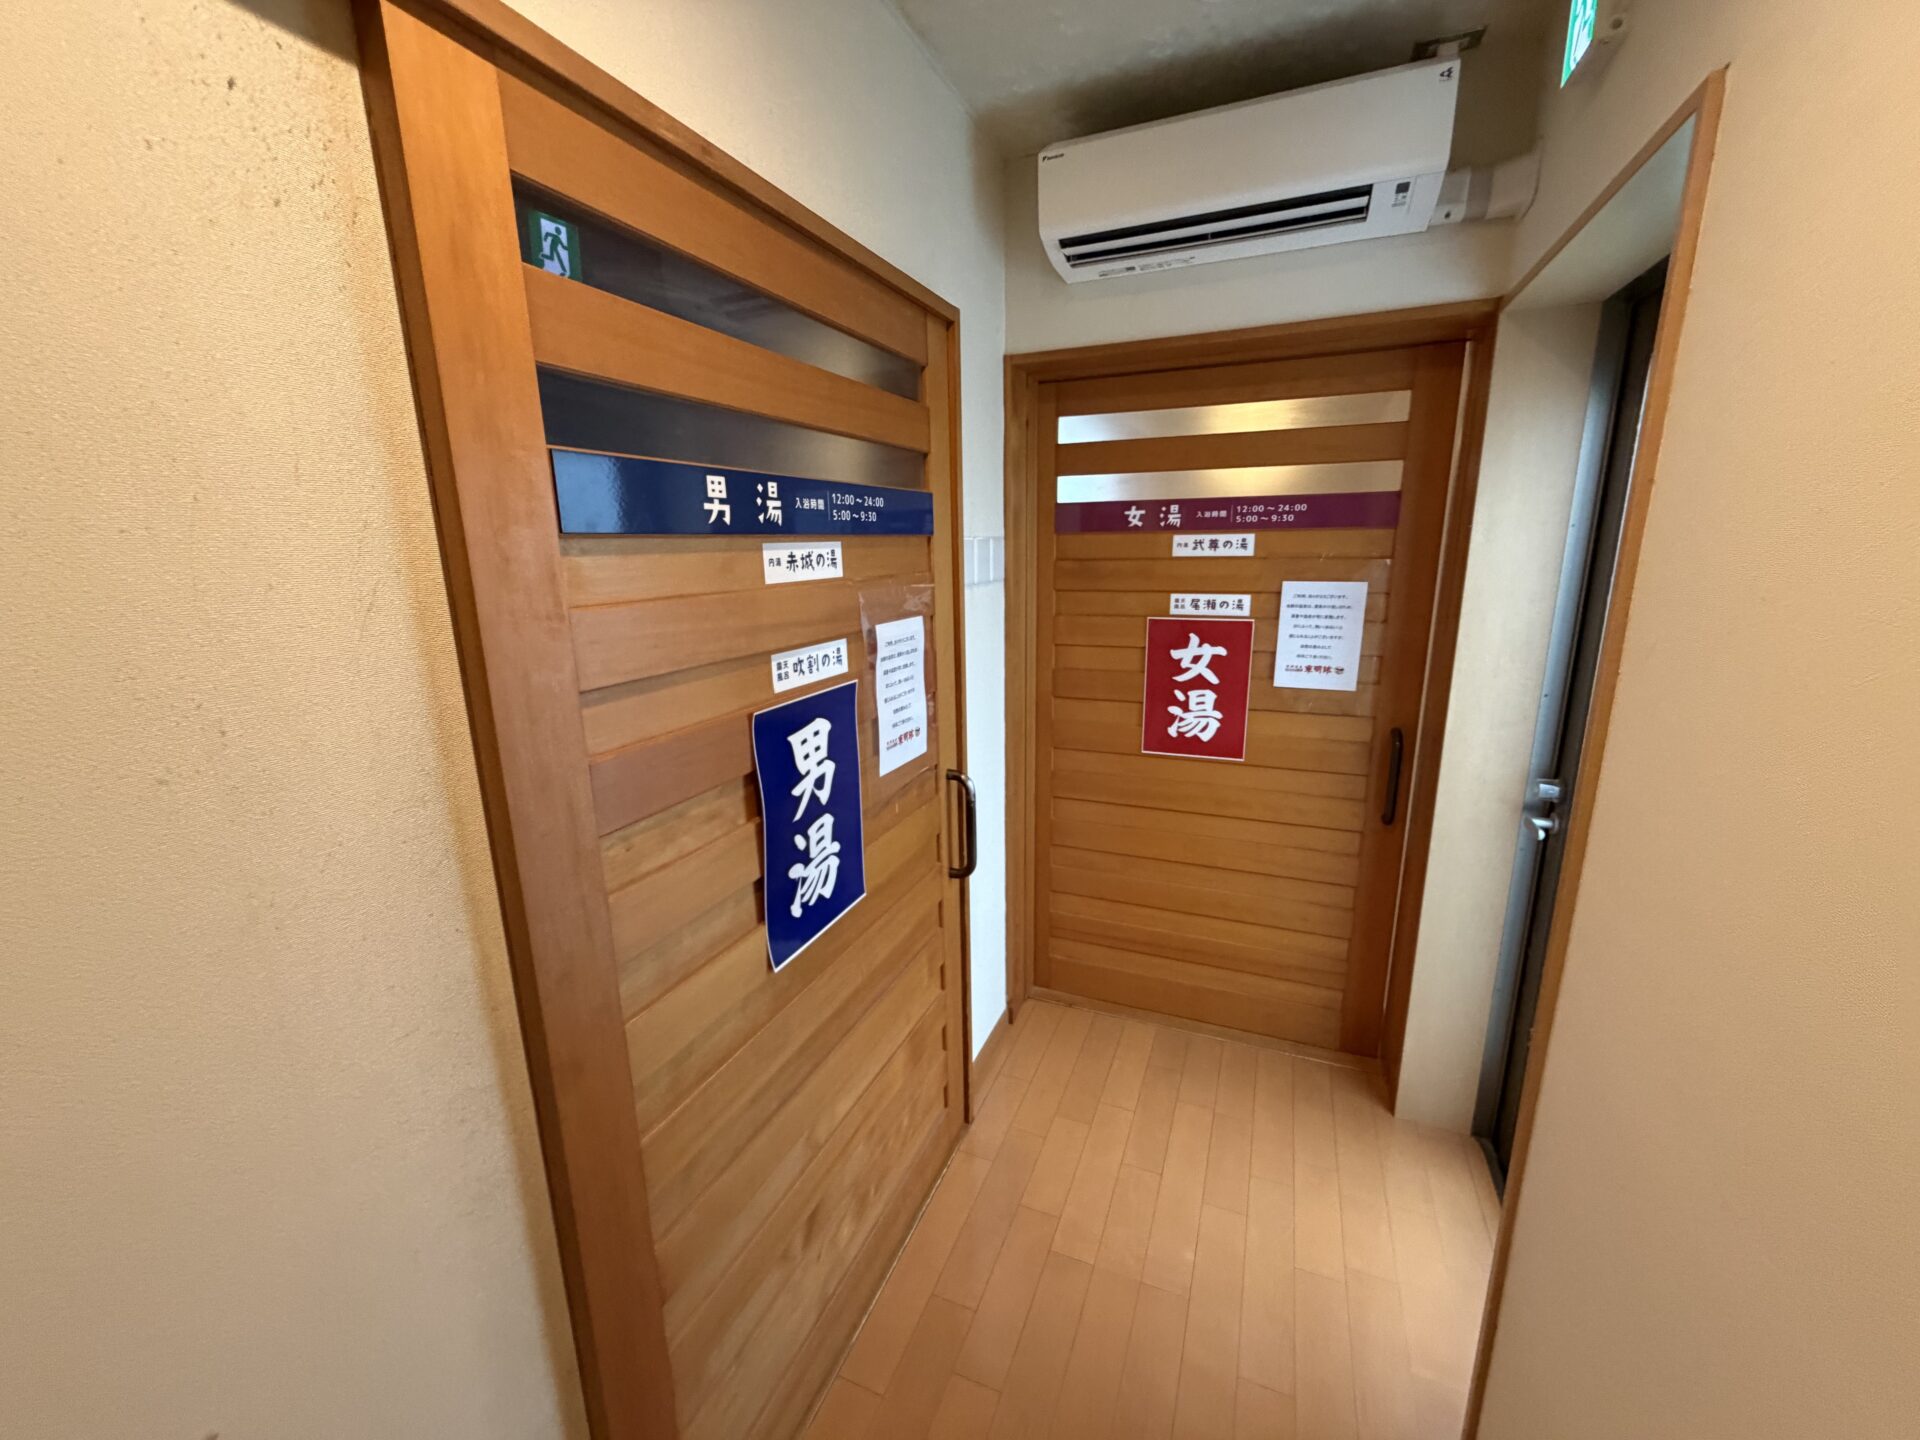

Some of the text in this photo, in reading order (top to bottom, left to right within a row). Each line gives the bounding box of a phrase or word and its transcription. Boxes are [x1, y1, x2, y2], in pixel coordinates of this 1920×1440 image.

[795, 497, 825, 510] 入浴時間
[786, 549, 838, 573] 赤城の湯
[792, 647, 843, 676] 吹割の湯
[1167, 633, 1228, 743] 女湯
[787, 717, 842, 918] 男湯
